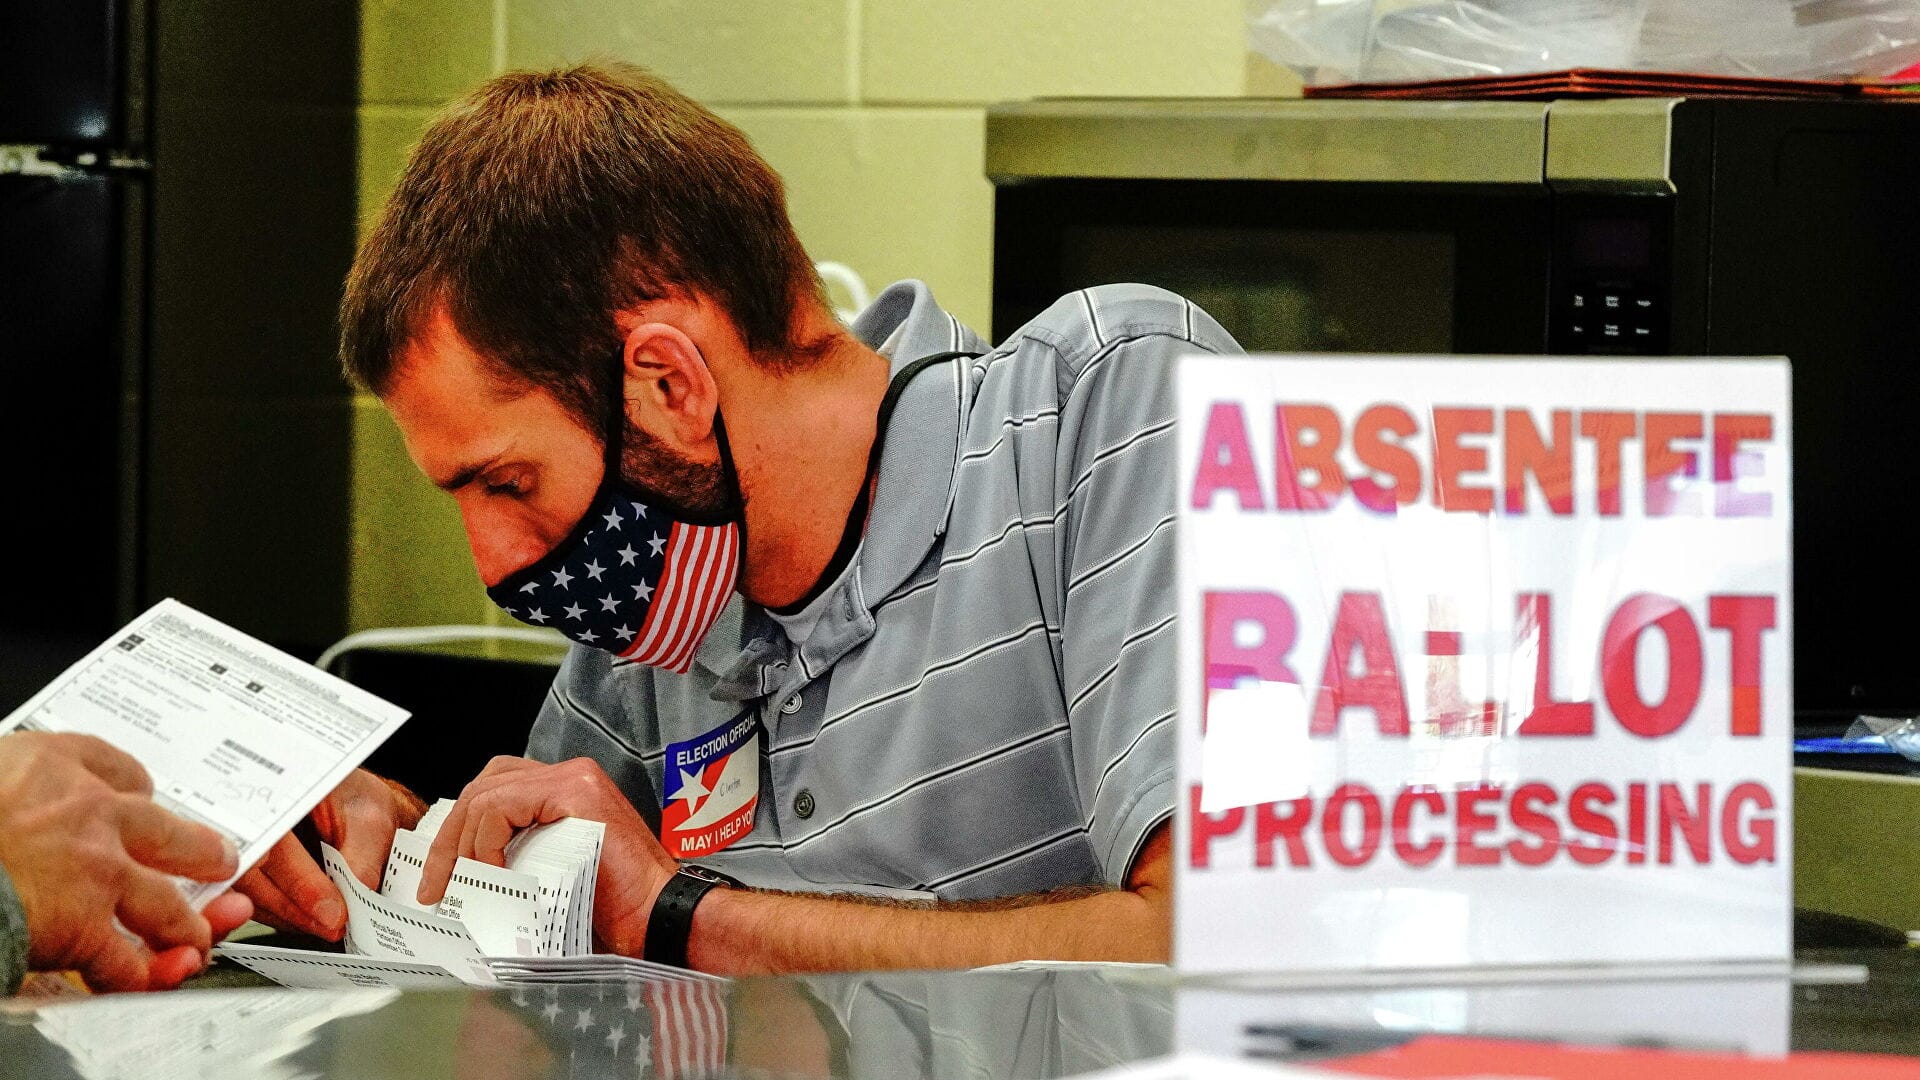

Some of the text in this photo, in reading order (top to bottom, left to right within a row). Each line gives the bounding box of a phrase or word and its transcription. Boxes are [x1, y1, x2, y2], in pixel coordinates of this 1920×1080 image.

[1191, 401, 1774, 517] ABSENTEE
[1202, 591, 1777, 739] BALLOT
[676, 711, 757, 767] ELECTION OFFICIAL
[681, 833, 712, 852] MAY
[714, 830, 719, 845] I
[719, 816, 742, 843] HELP
[1189, 781, 1777, 869] PROCESSING
[449, 895, 463, 910] Ballot
